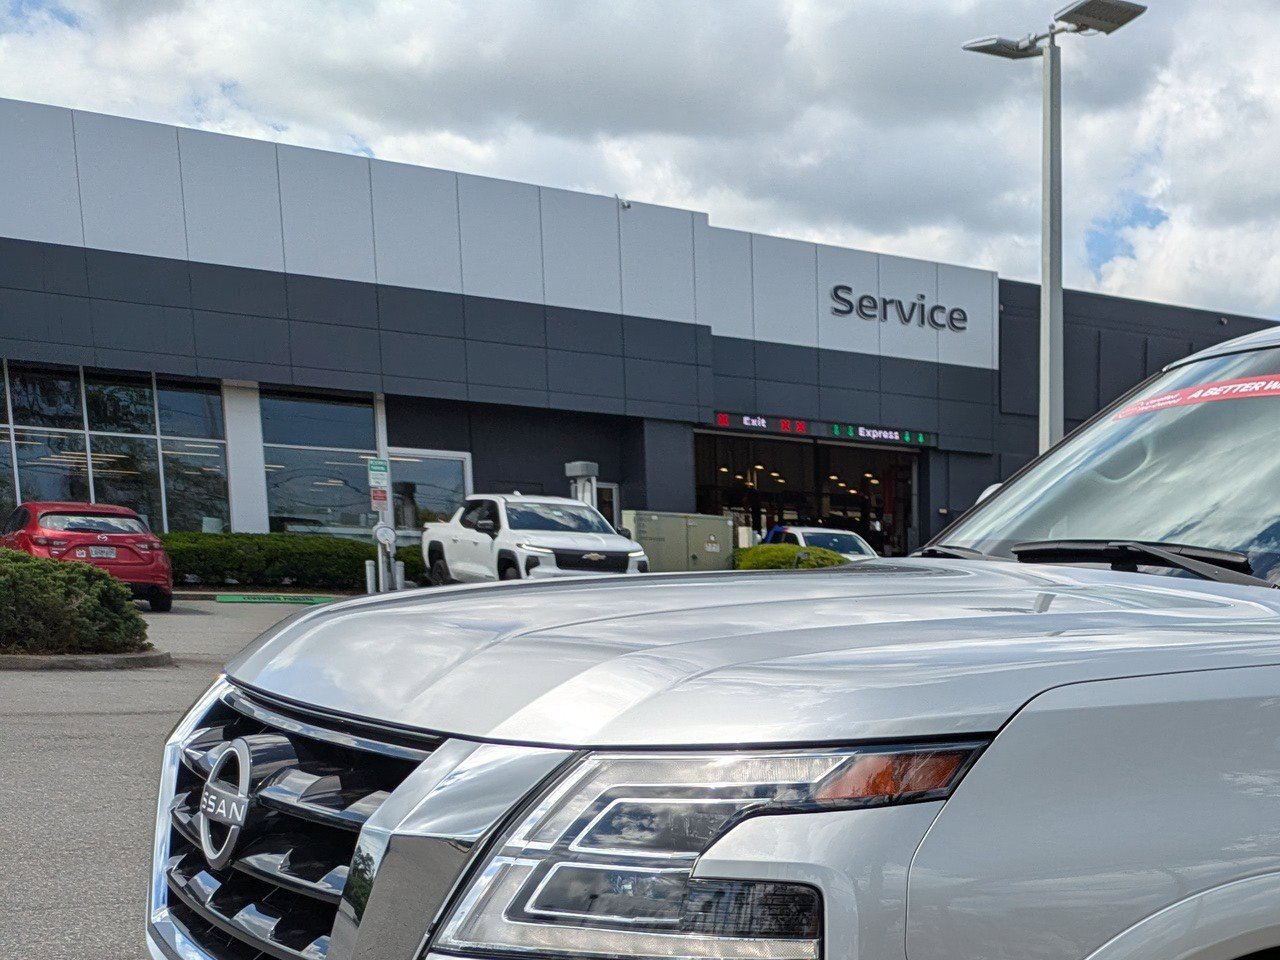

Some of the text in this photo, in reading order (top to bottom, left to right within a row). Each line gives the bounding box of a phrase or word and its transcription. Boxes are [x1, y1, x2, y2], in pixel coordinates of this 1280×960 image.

[831, 284, 969, 333] Service
[1187, 388, 1201, 400] A
[1201, 381, 1266, 398] BETTER
[742, 416, 767, 428] Exit
[858, 426, 900, 440] Express
[201, 791, 245, 822] SSAN
